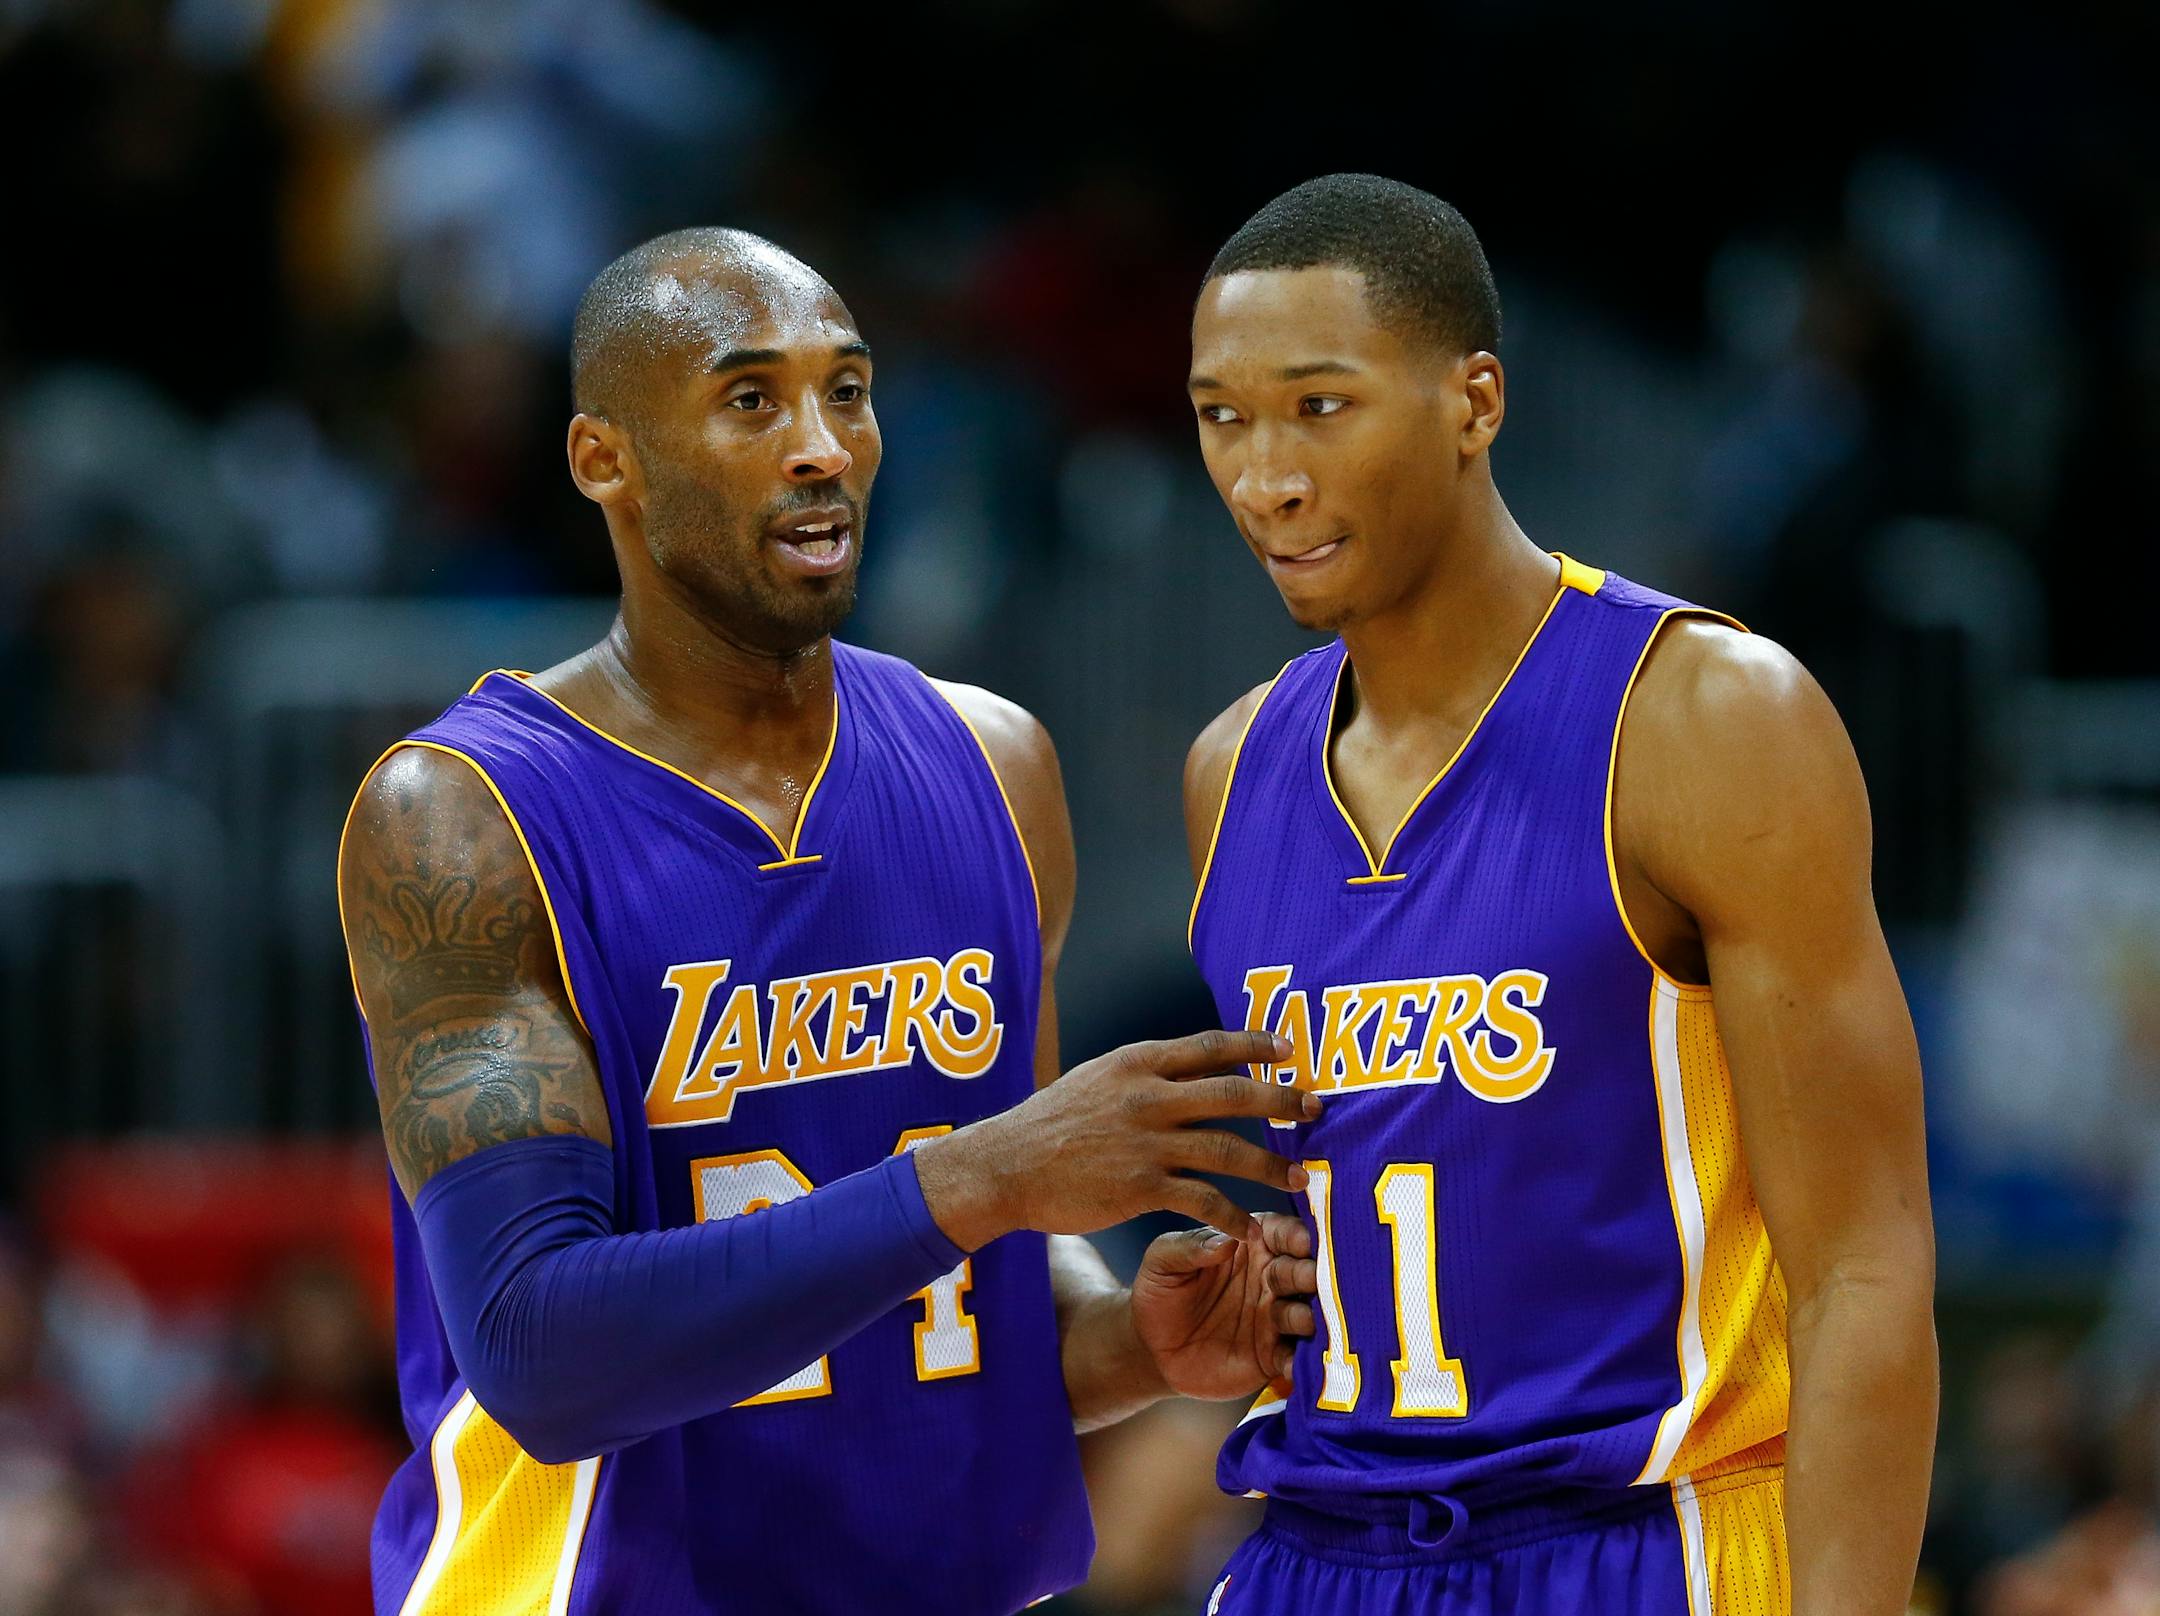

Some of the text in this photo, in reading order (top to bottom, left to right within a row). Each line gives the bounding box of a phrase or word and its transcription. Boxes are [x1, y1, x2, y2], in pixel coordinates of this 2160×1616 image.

[644, 947, 1004, 1129] LAKERS
[1242, 964, 1557, 1129] LAKERS
[1303, 1159, 1468, 1418] 11
